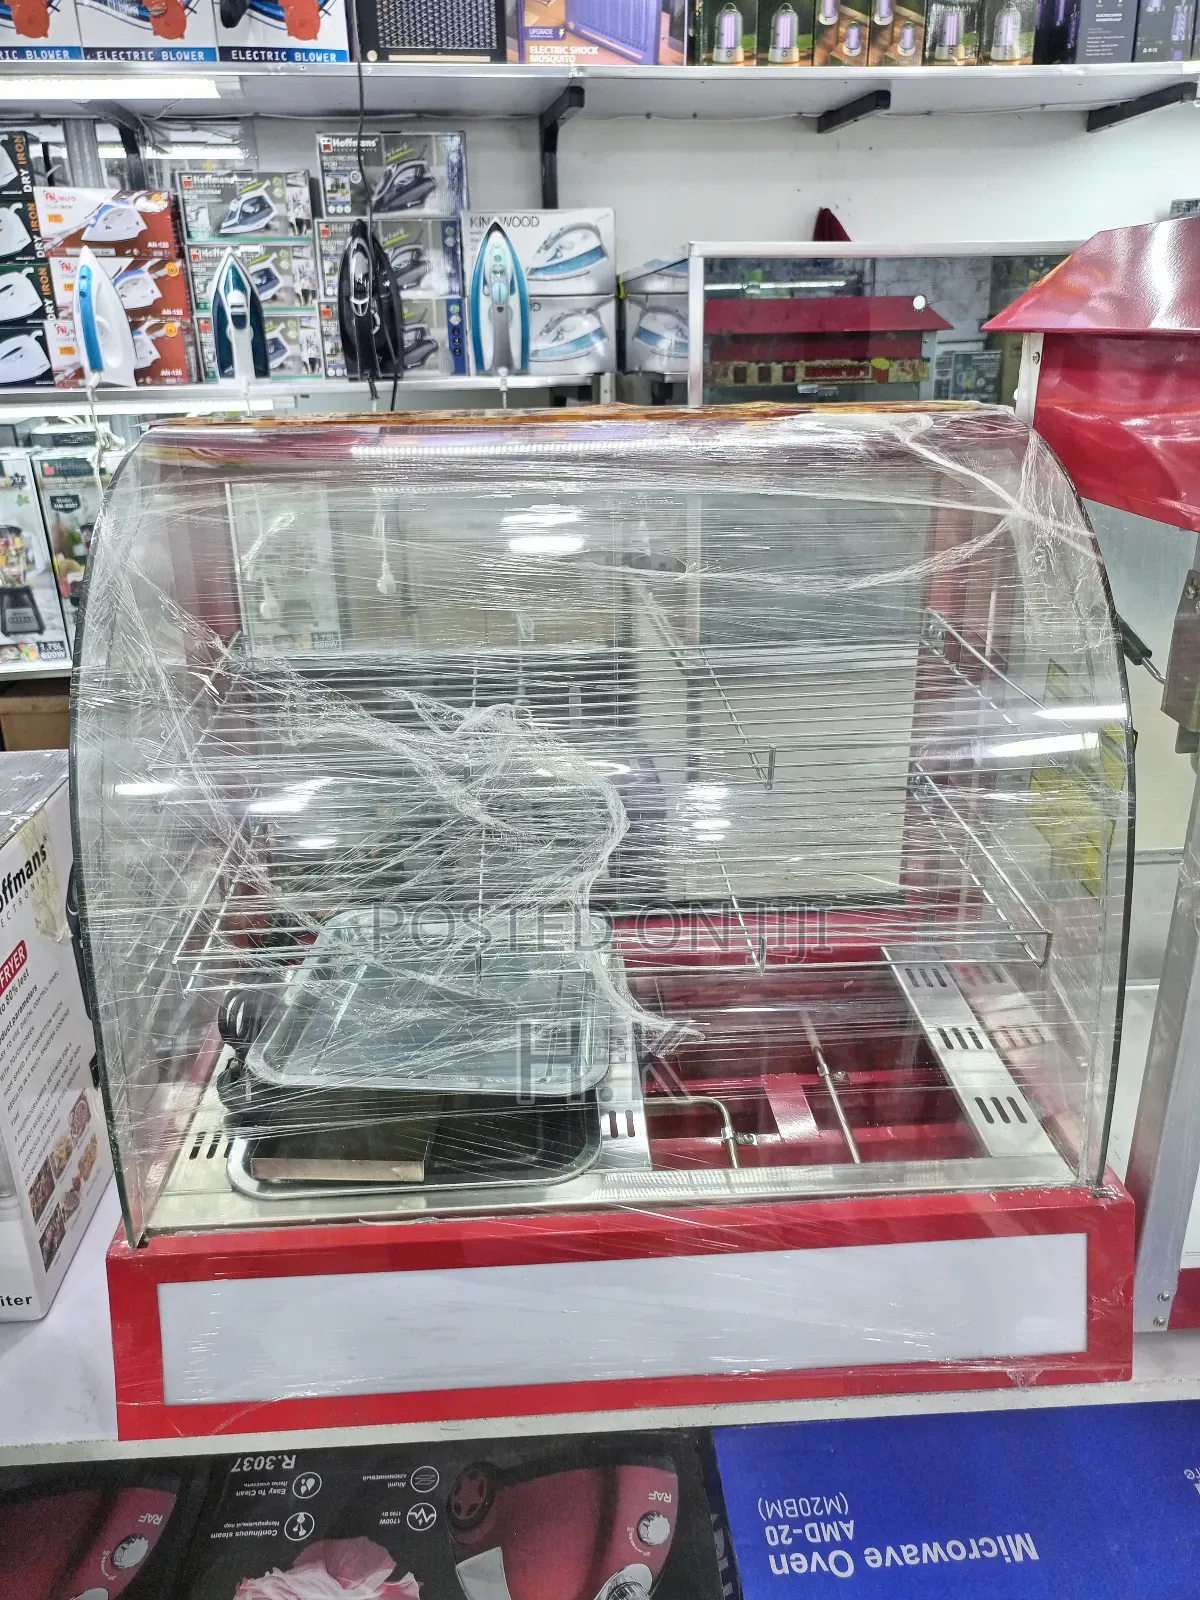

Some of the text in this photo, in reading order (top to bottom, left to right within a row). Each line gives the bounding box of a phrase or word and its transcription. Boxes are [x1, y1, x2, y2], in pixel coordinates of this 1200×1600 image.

[25, 51, 70, 60] BLOWER
[97, 51, 205, 61] ELECTRIC BLOWER
[231, 50, 337, 62] ELECTRIC BLOWER
[529, 46, 600, 55] ELECTRIC SHOCK
[529, 55, 576, 63] MOSQUITO
[14, 135, 33, 193] DRY IRON
[27, 202, 46, 259] DRY IRON
[38, 267, 51, 296] IRON
[0, 984, 38, 1045] duct parameters
[230, 1454, 297, 1473] R.3037
[236, 1487, 287, 1497] Easy To Clean
[648, 1491, 672, 1503] RAF
[757, 1491, 850, 1522] (M20BM)
[138, 1513, 164, 1526] RAF
[210, 1529, 278, 1539] Continuous steam
[764, 1519, 855, 1547] AMD-20
[768, 1532, 1040, 1578] Microwave Oven
